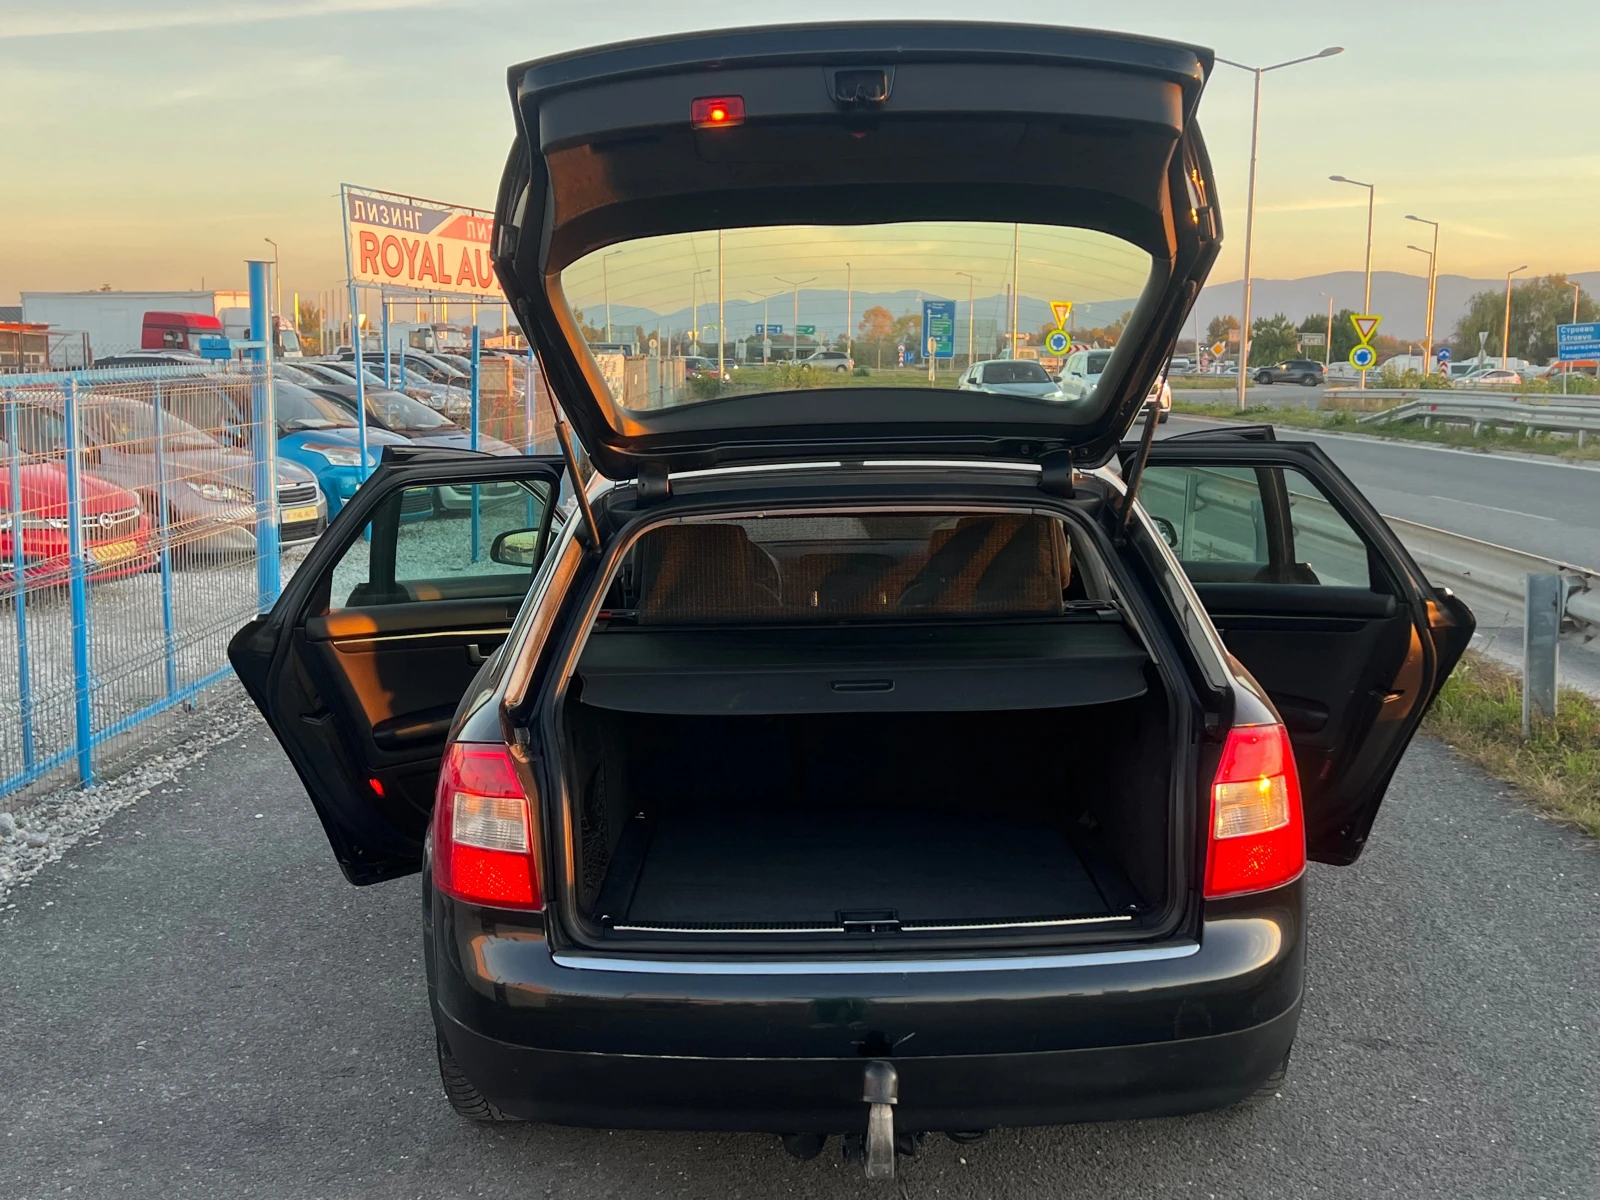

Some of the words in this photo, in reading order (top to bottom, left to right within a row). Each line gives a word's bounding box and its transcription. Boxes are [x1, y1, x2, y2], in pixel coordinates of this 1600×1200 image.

[354, 200, 423, 230] ЛИЗИНГ
[359, 230, 452, 285] ROYAL
[456, 246, 503, 290] AU
